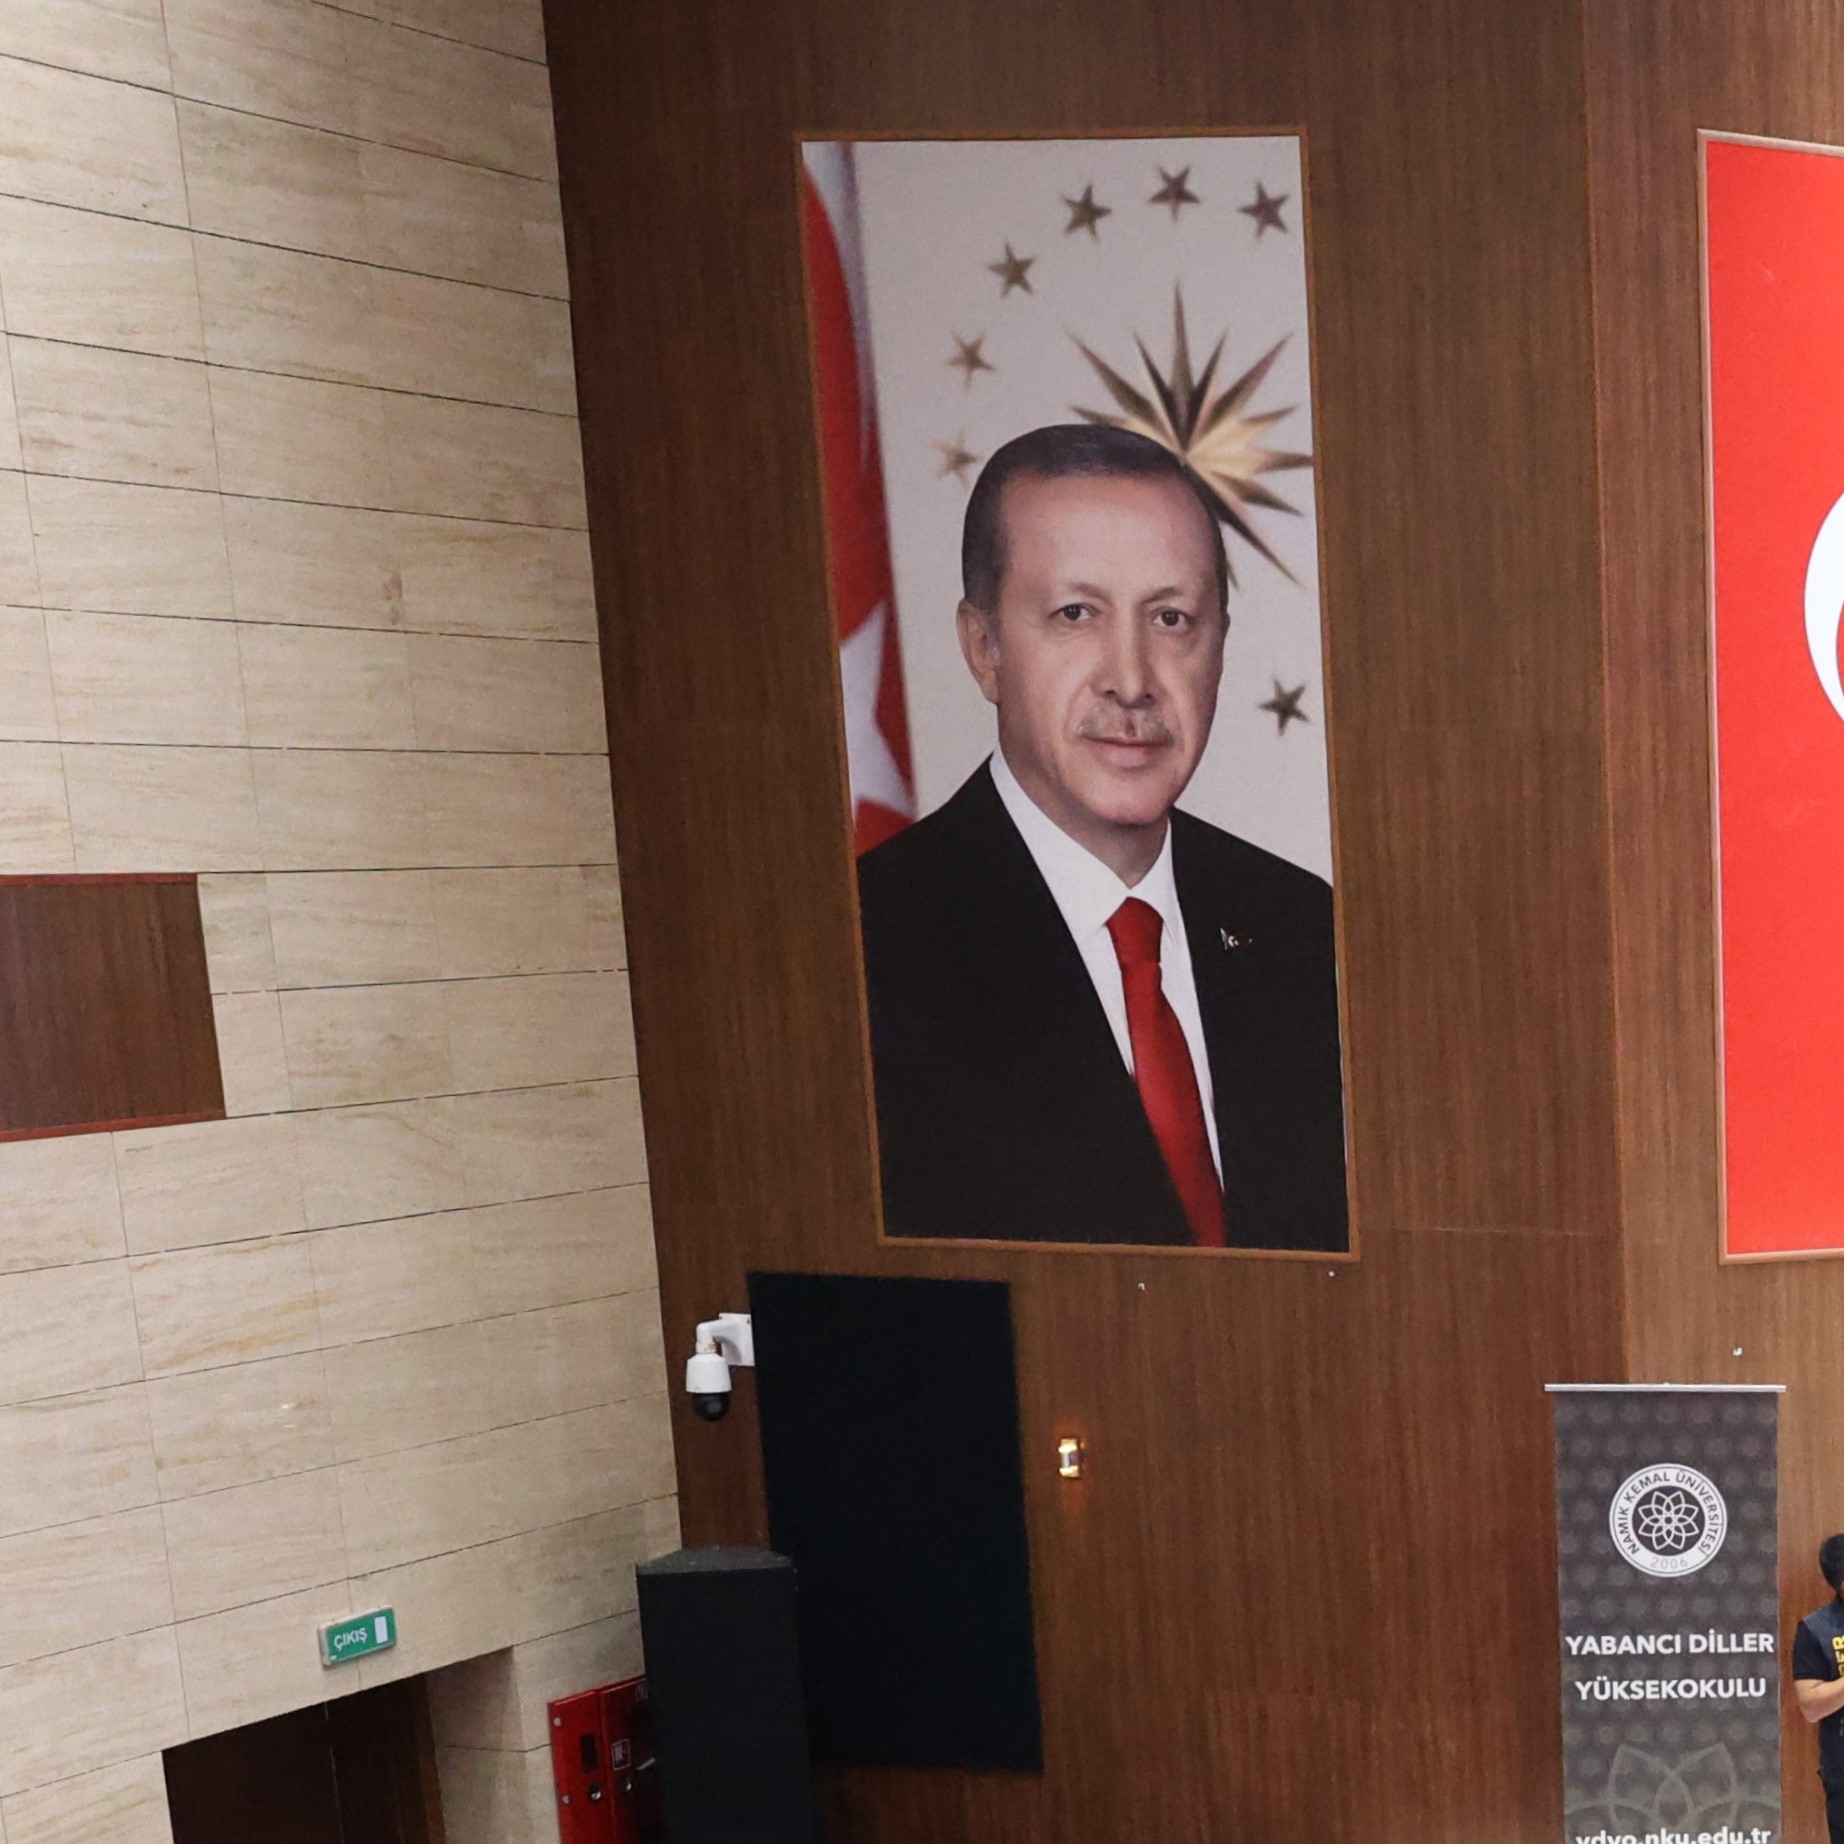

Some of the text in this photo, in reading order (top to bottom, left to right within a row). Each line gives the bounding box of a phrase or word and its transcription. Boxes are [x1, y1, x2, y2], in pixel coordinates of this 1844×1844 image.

[1623, 1471, 1671, 1503] KEMAL
[1618, 1506, 1640, 1555] NAMIK
[1650, 1556, 1688, 1570] 2006
[333, 1627, 368, 1651] ÇIKIŞ
[1565, 1628, 1775, 1656] YABANCI DİLLER
[1574, 1675, 1767, 1701] YÜKSEKOKULU
